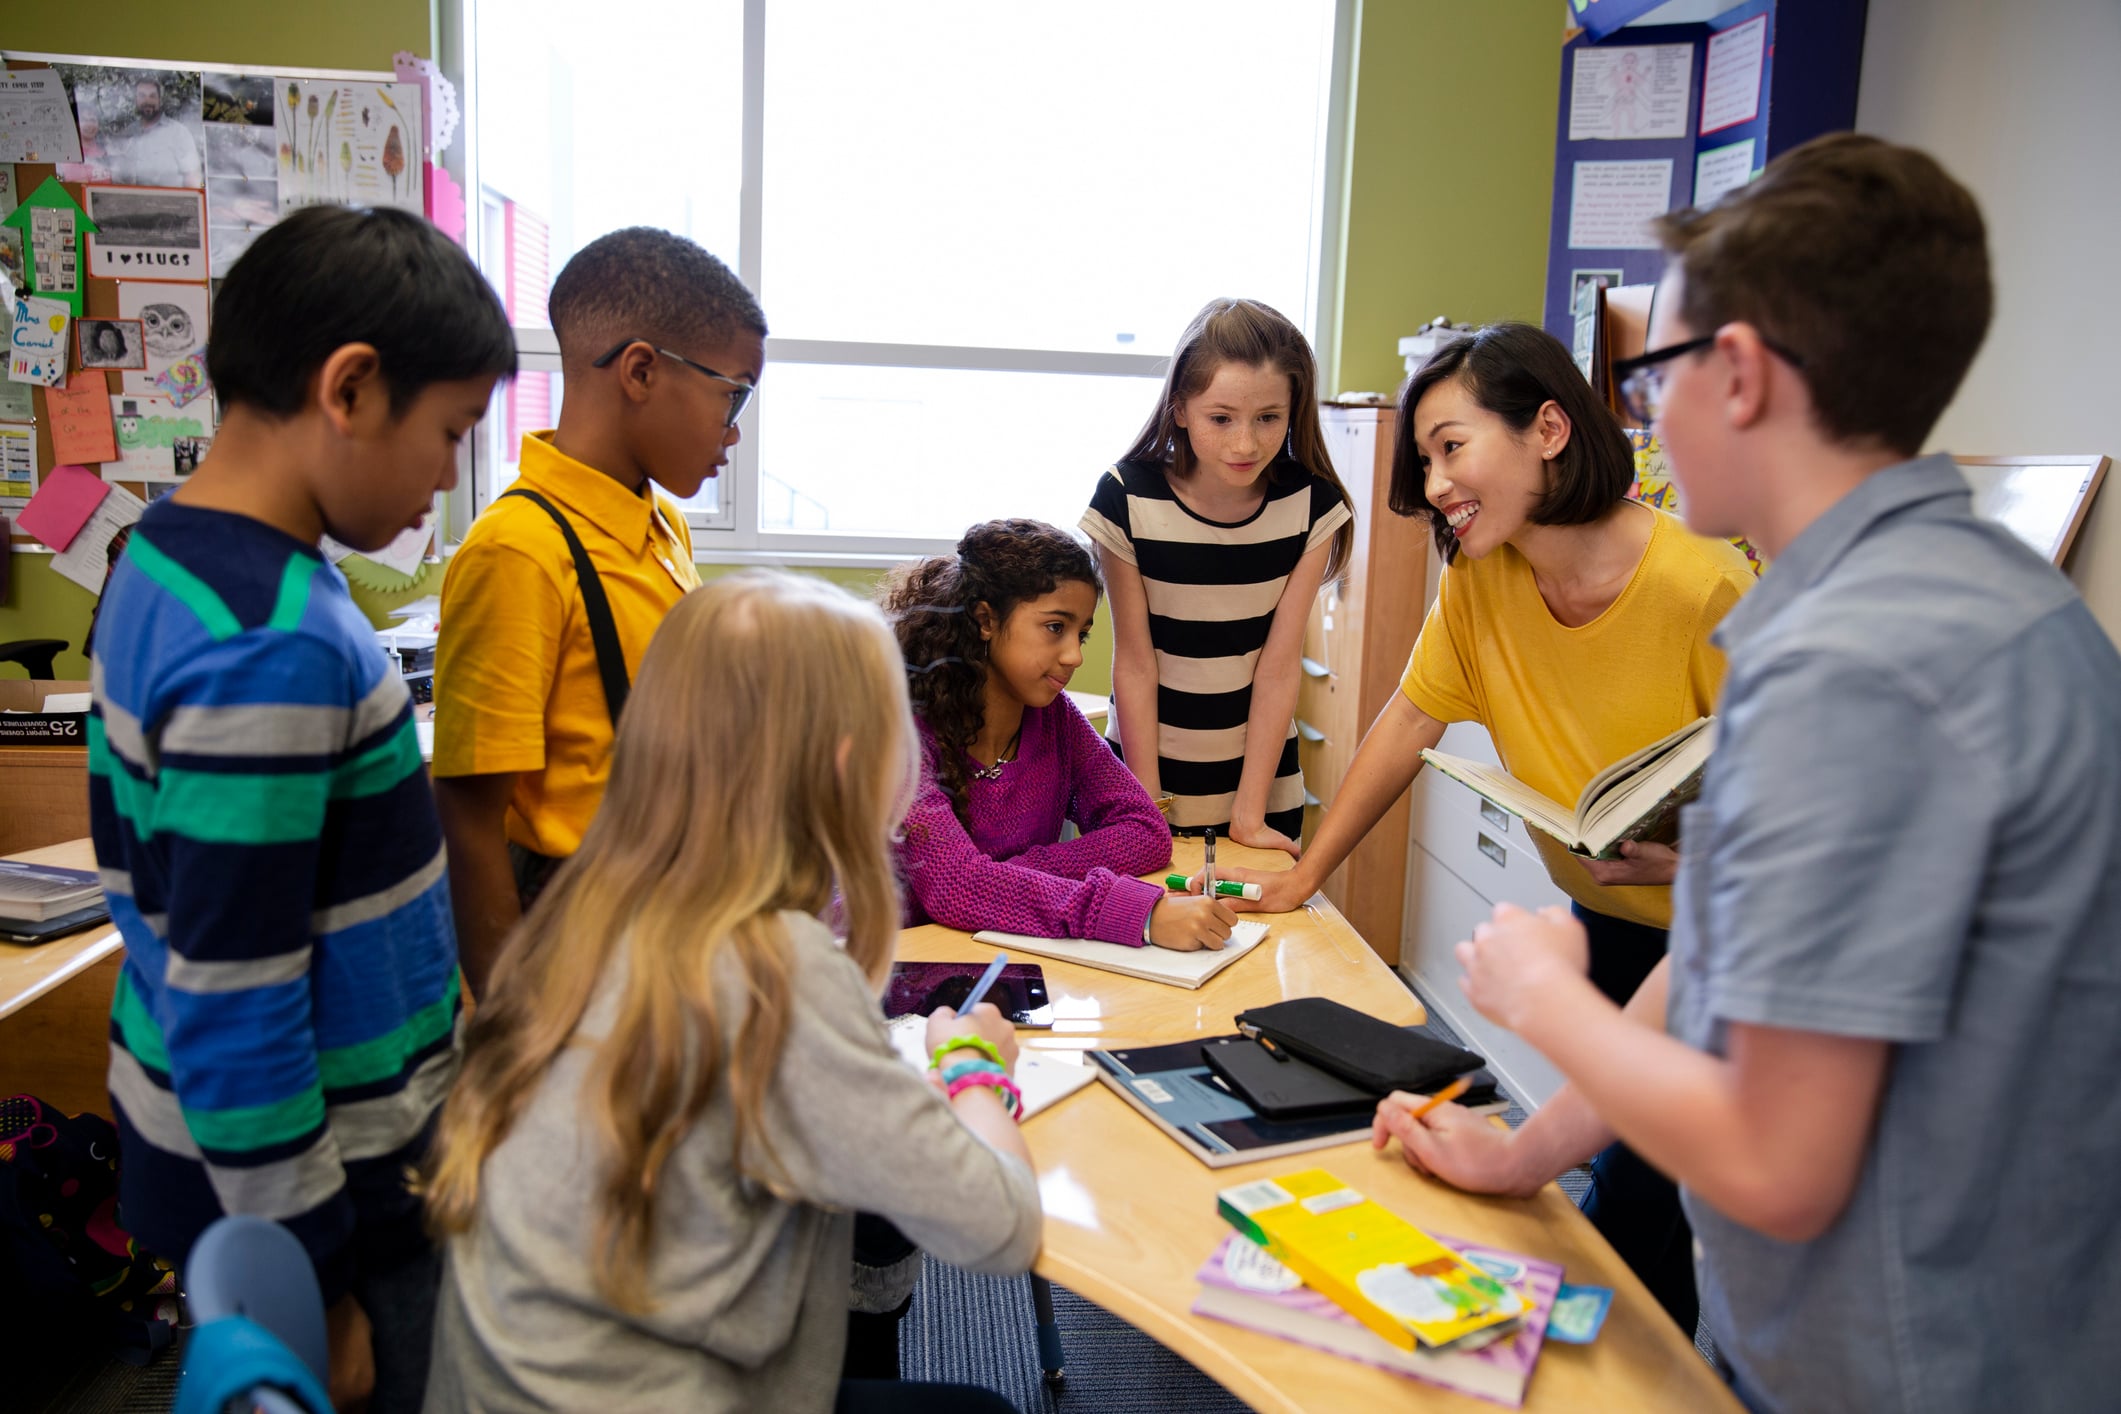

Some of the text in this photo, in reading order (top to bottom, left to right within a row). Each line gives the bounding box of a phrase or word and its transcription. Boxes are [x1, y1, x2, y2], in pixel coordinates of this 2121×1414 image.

[107, 251, 190, 266] I SLUGS
[49, 720, 78, 736] 25
